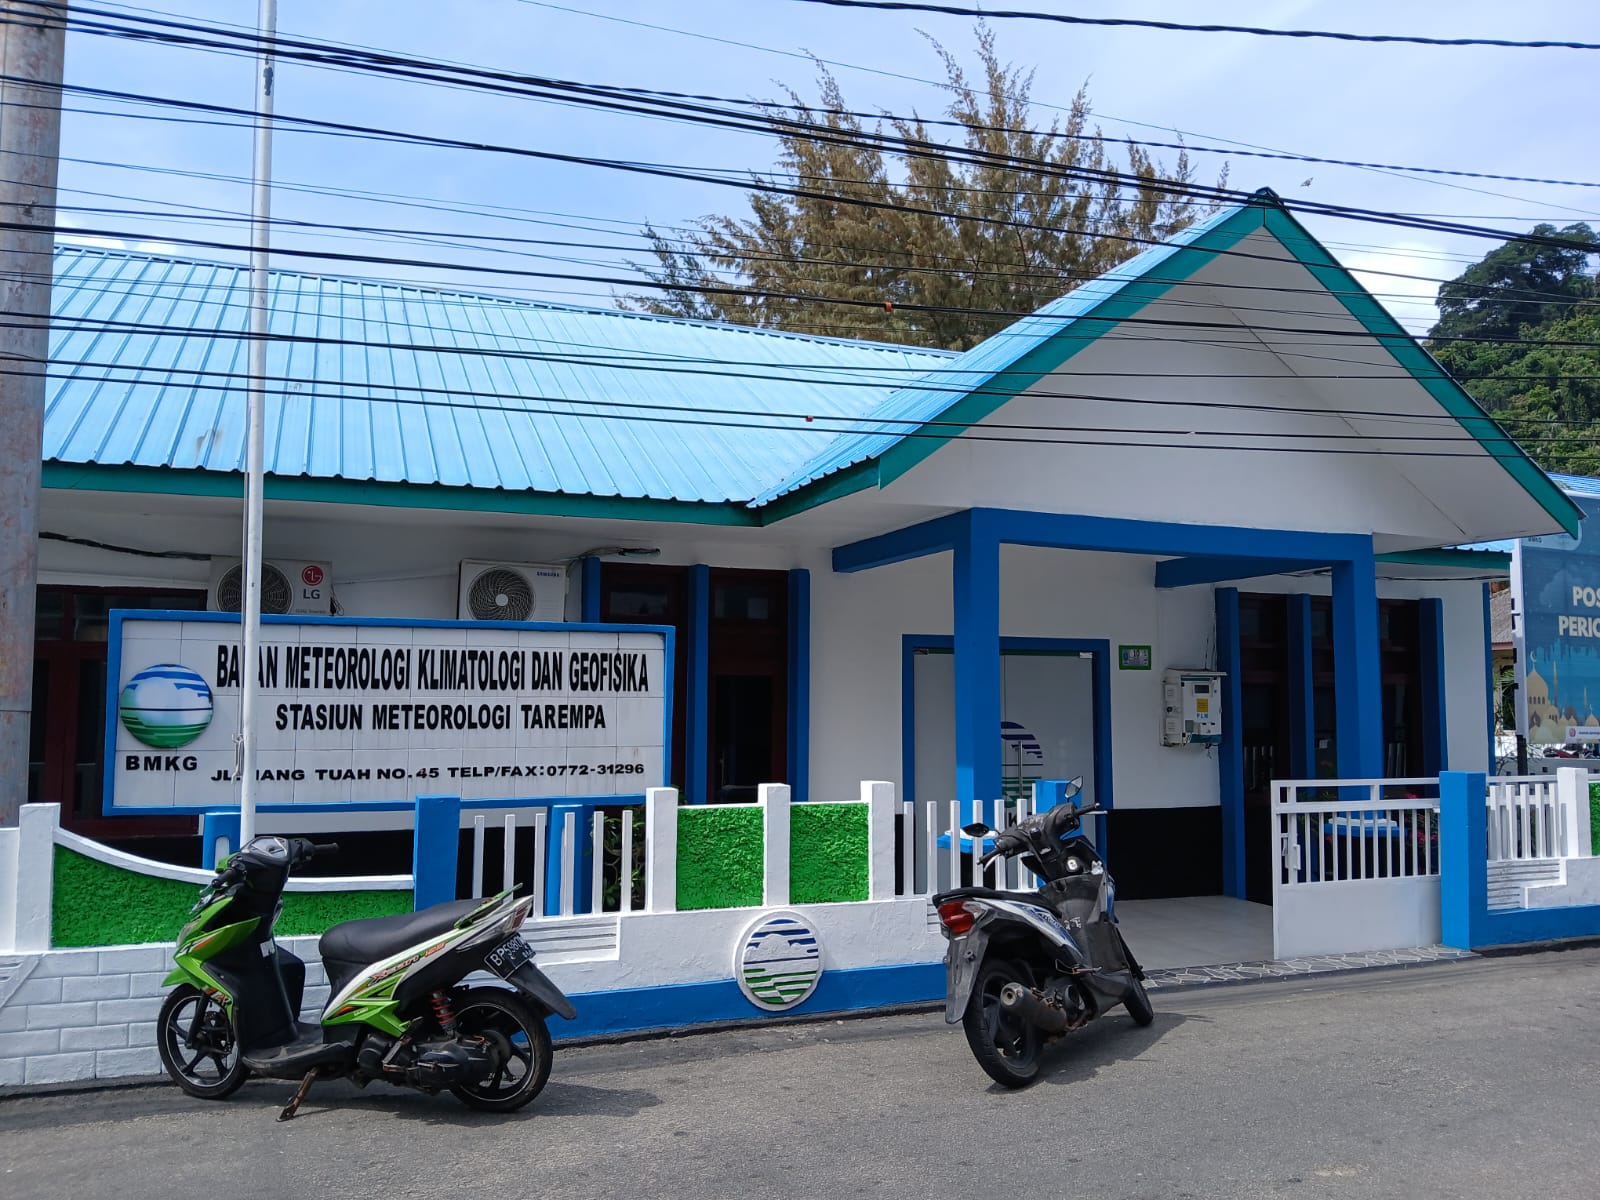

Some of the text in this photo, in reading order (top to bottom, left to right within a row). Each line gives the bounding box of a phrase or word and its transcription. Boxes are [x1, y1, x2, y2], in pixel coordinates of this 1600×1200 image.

[303, 588, 321, 600] LG
[217, 645, 649, 692] BAN METEOROLOGI KLIMATOLOGI DAN GEOFISIKA
[275, 703, 607, 731] STASIUN METEOROLOGI TAREMPA
[125, 755, 198, 772] BMKG
[256, 768, 305, 781] ANG
[315, 768, 371, 781] TUAH
